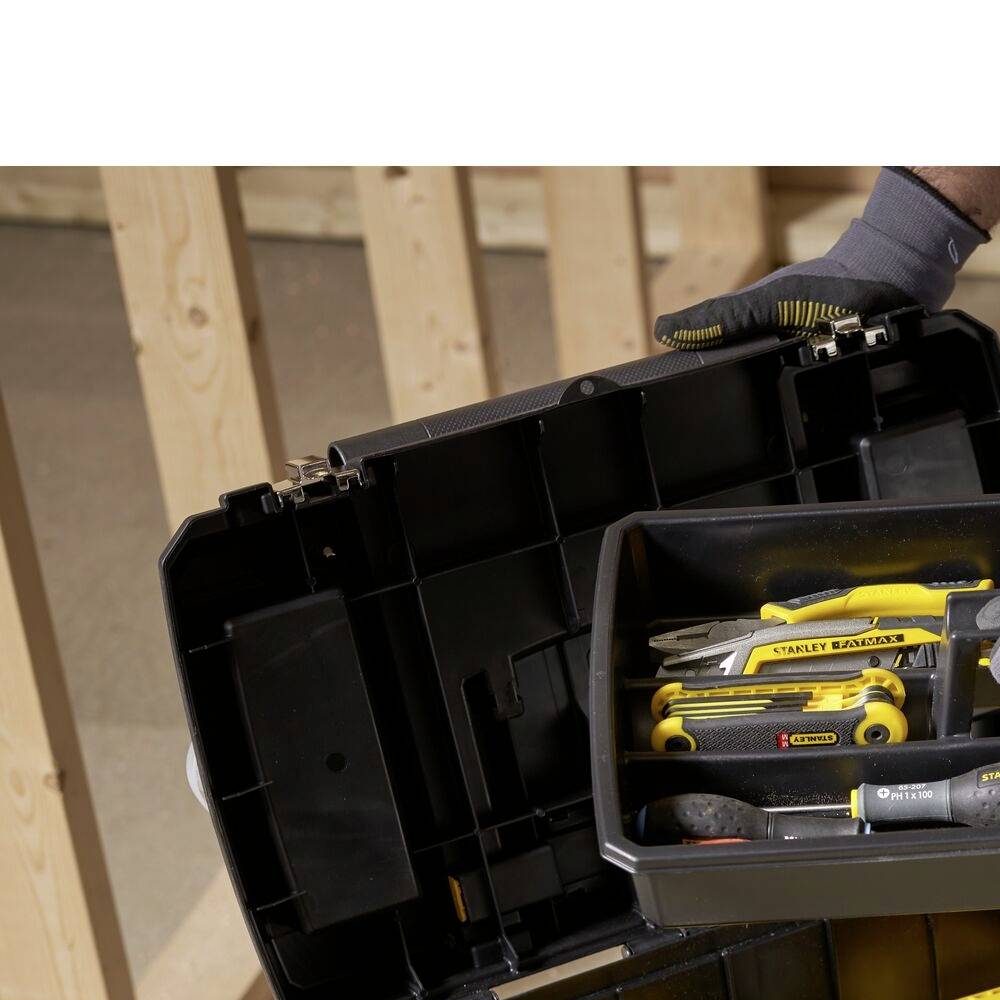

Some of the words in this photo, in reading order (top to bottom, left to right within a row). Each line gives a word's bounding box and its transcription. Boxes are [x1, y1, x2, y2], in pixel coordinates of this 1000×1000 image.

[773, 642, 827, 656] STANLEY
[793, 734, 834, 743] STANLEY
[891, 792, 903, 801] PH
[904, 791, 909, 800] 1
[918, 790, 933, 799] 100
